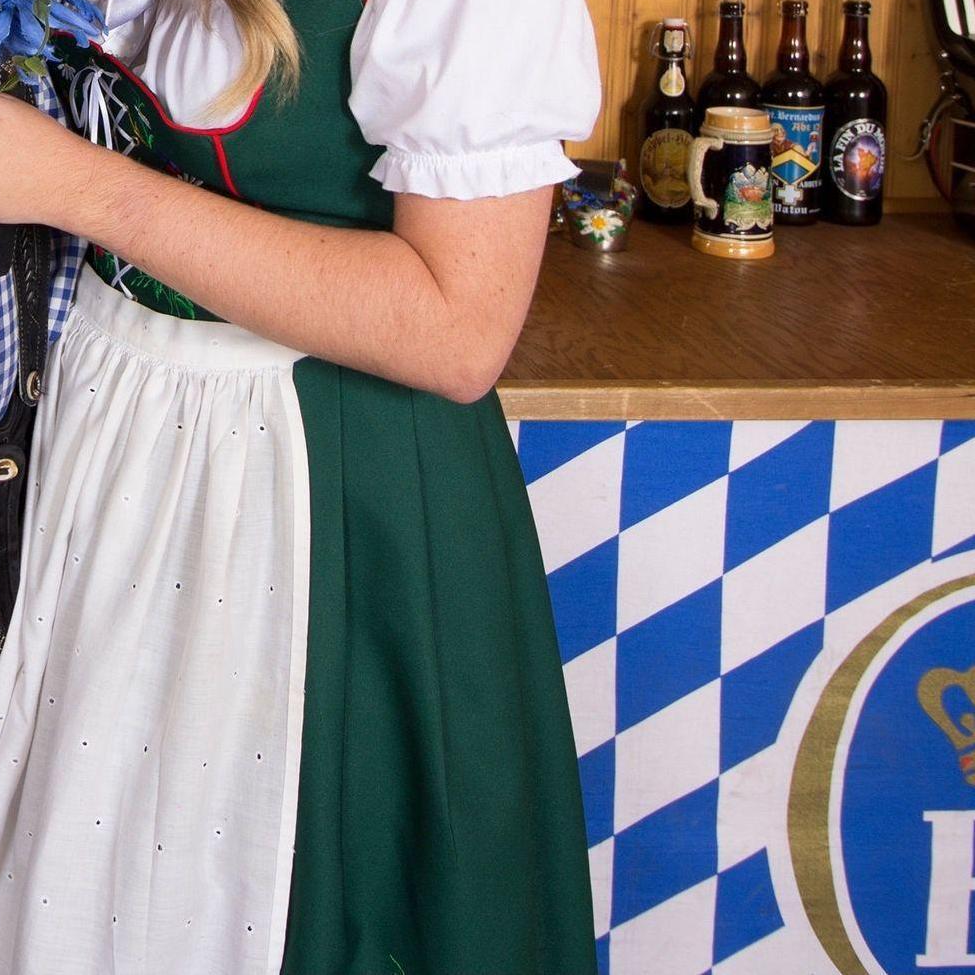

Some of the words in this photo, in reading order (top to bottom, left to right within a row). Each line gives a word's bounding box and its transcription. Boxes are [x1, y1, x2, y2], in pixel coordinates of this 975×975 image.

[855, 123, 876, 135] DU
[835, 128, 855, 152] FIN
[832, 153, 844, 172] LA
